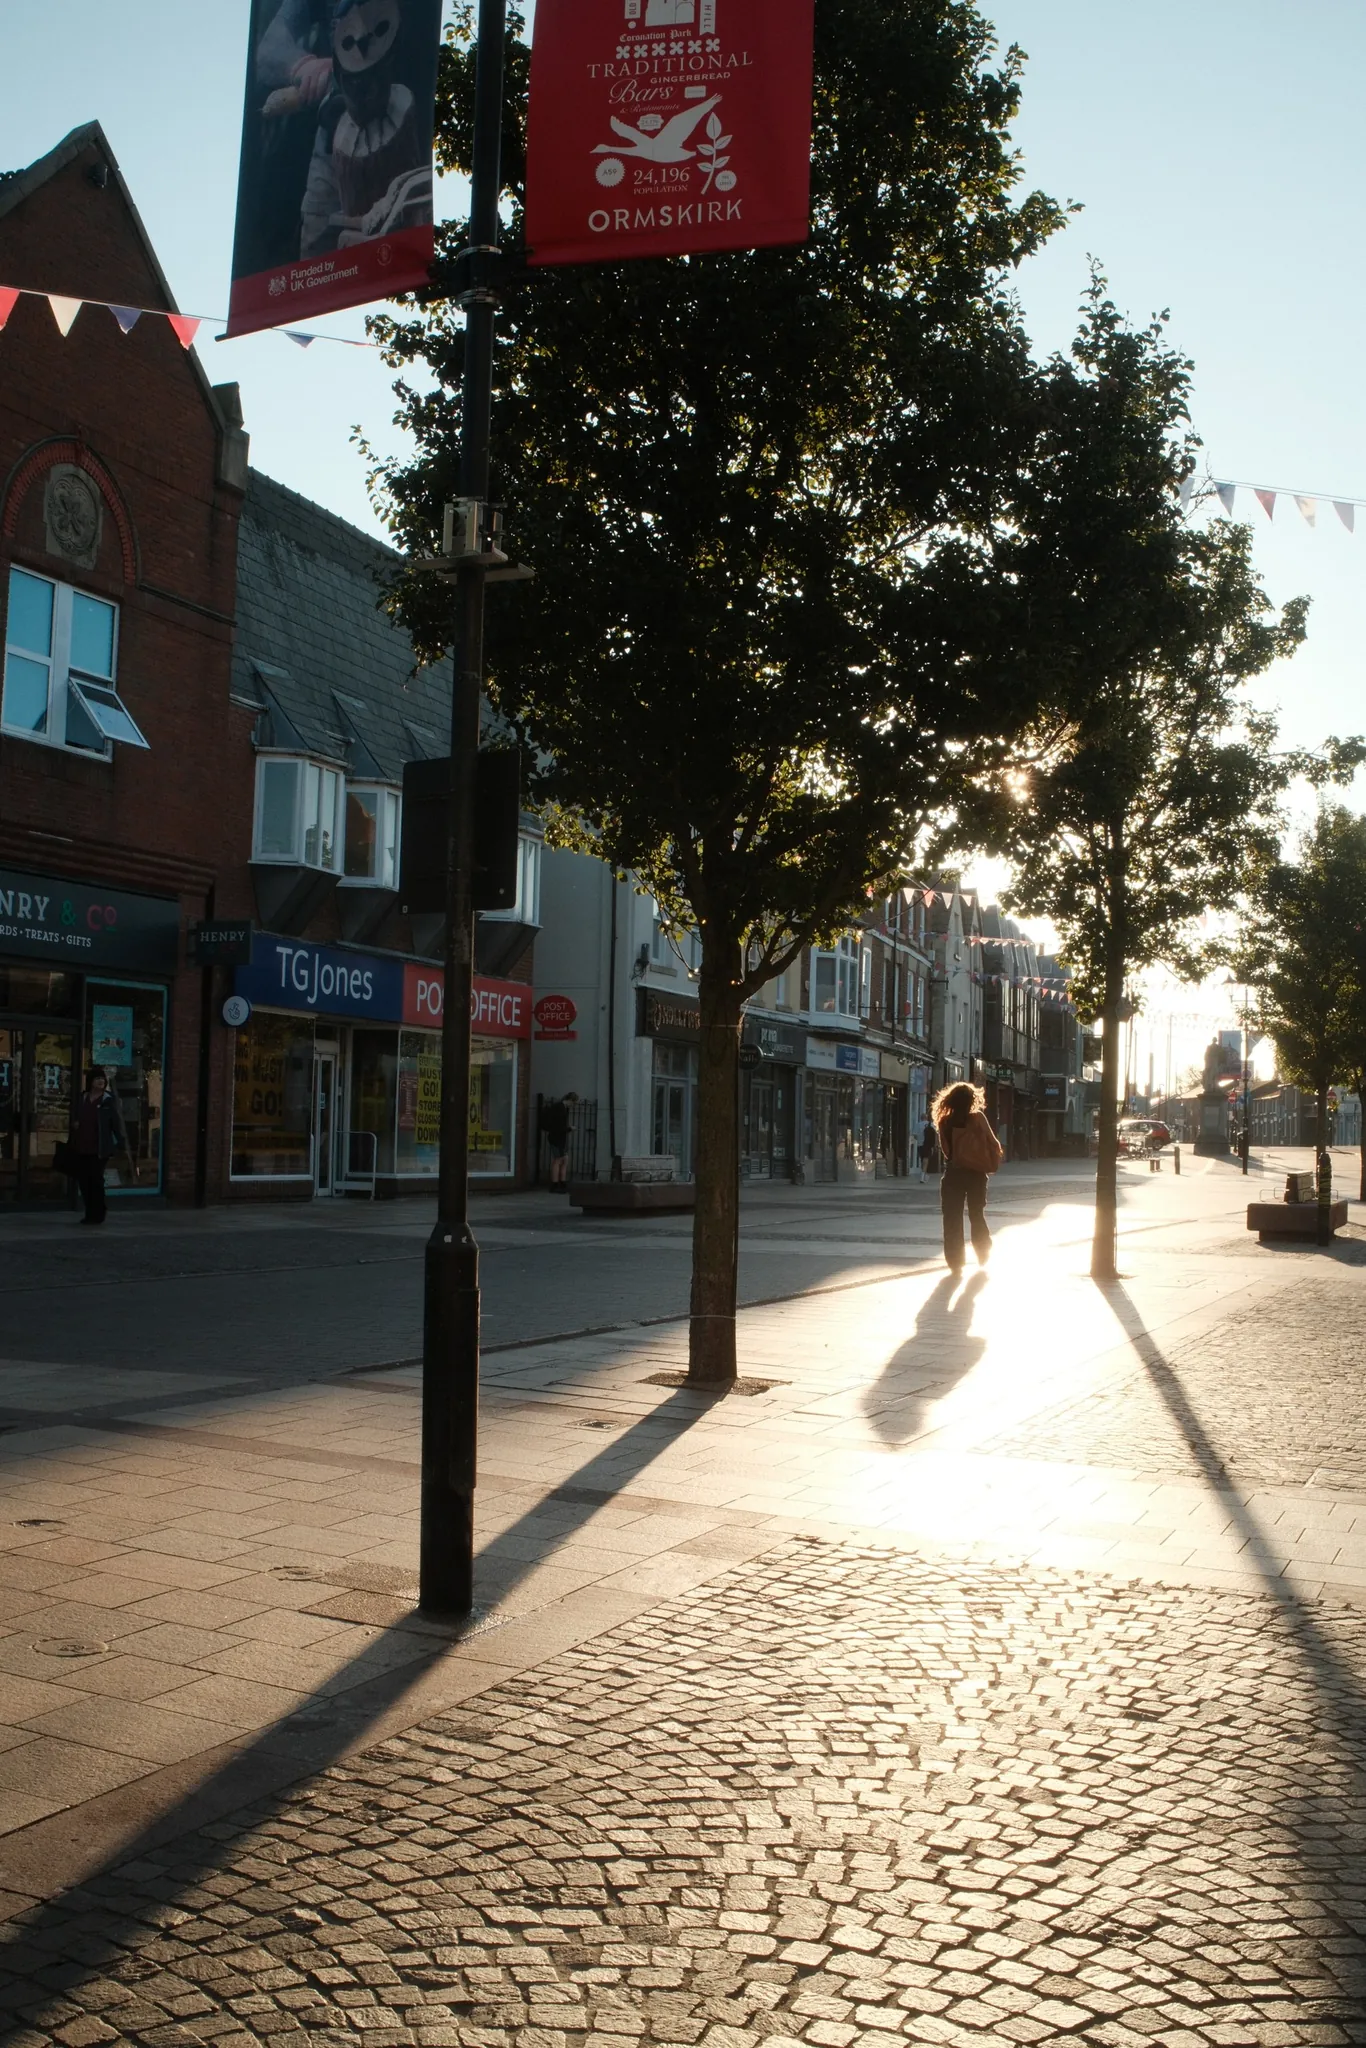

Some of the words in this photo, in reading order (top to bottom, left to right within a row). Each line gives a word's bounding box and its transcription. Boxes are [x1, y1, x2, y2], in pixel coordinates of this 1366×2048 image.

[703, 4, 712, 28] HILL
[619, 32, 666, 42] Coronation
[669, 29, 692, 39] Park
[587, 51, 753, 79] TRADITIONAL
[649, 71, 731, 84] GINGERBREAD
[608, 78, 677, 104] Bars
[633, 166, 690, 185] 24,196
[633, 183, 688, 195] POPULATION
[588, 197, 743, 232] ORMSKIRK
[290, 262, 323, 280] Funded
[324, 260, 335, 272] by
[290, 280, 305, 291] UK
[306, 265, 359, 288] Government
[0, 888, 50, 921] NRY
[59, 898, 77, 926] &
[0, 924, 18, 936] RDS
[25, 927, 60, 943] TREATS
[66, 934, 92, 947] GIFTS
[200, 930, 246, 943] HENRY
[417, 979, 444, 1015] PO
[543, 1002, 568, 1012] POST
[537, 1012, 571, 1021] OFFICE
[419, 1068, 442, 1080] MUST
[423, 1080, 439, 1098] GO!
[251, 1088, 282, 1117] GO!
